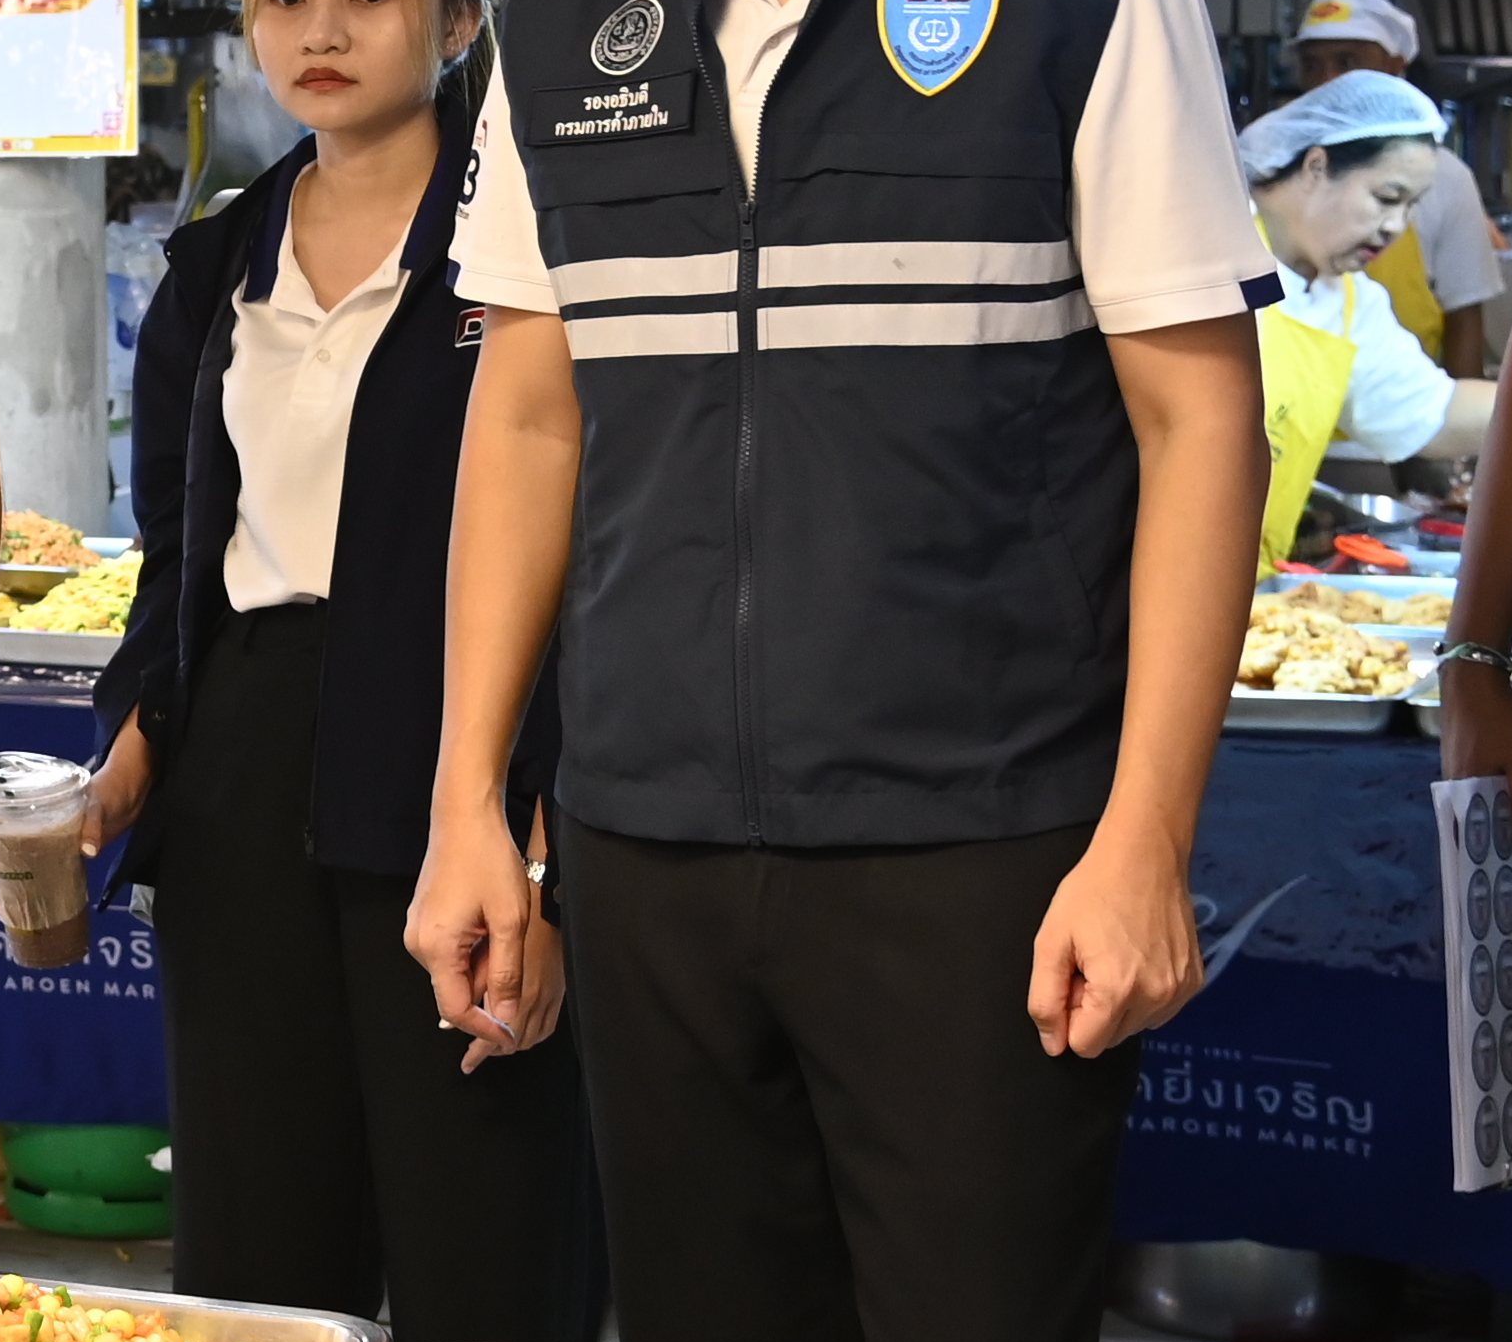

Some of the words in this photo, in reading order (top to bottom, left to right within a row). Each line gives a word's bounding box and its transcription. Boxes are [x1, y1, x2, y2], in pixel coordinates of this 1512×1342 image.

[582, 81, 650, 111] รองอธิบดี
[554, 104, 669, 137] กรมการค้าภายใน
[103, 981, 156, 1001] MAR
[1136, 1060, 1375, 1136] ยิ่งเจริญ
[1125, 1114, 1243, 1141] AROEN
[1257, 1127, 1373, 1160] MARKET
